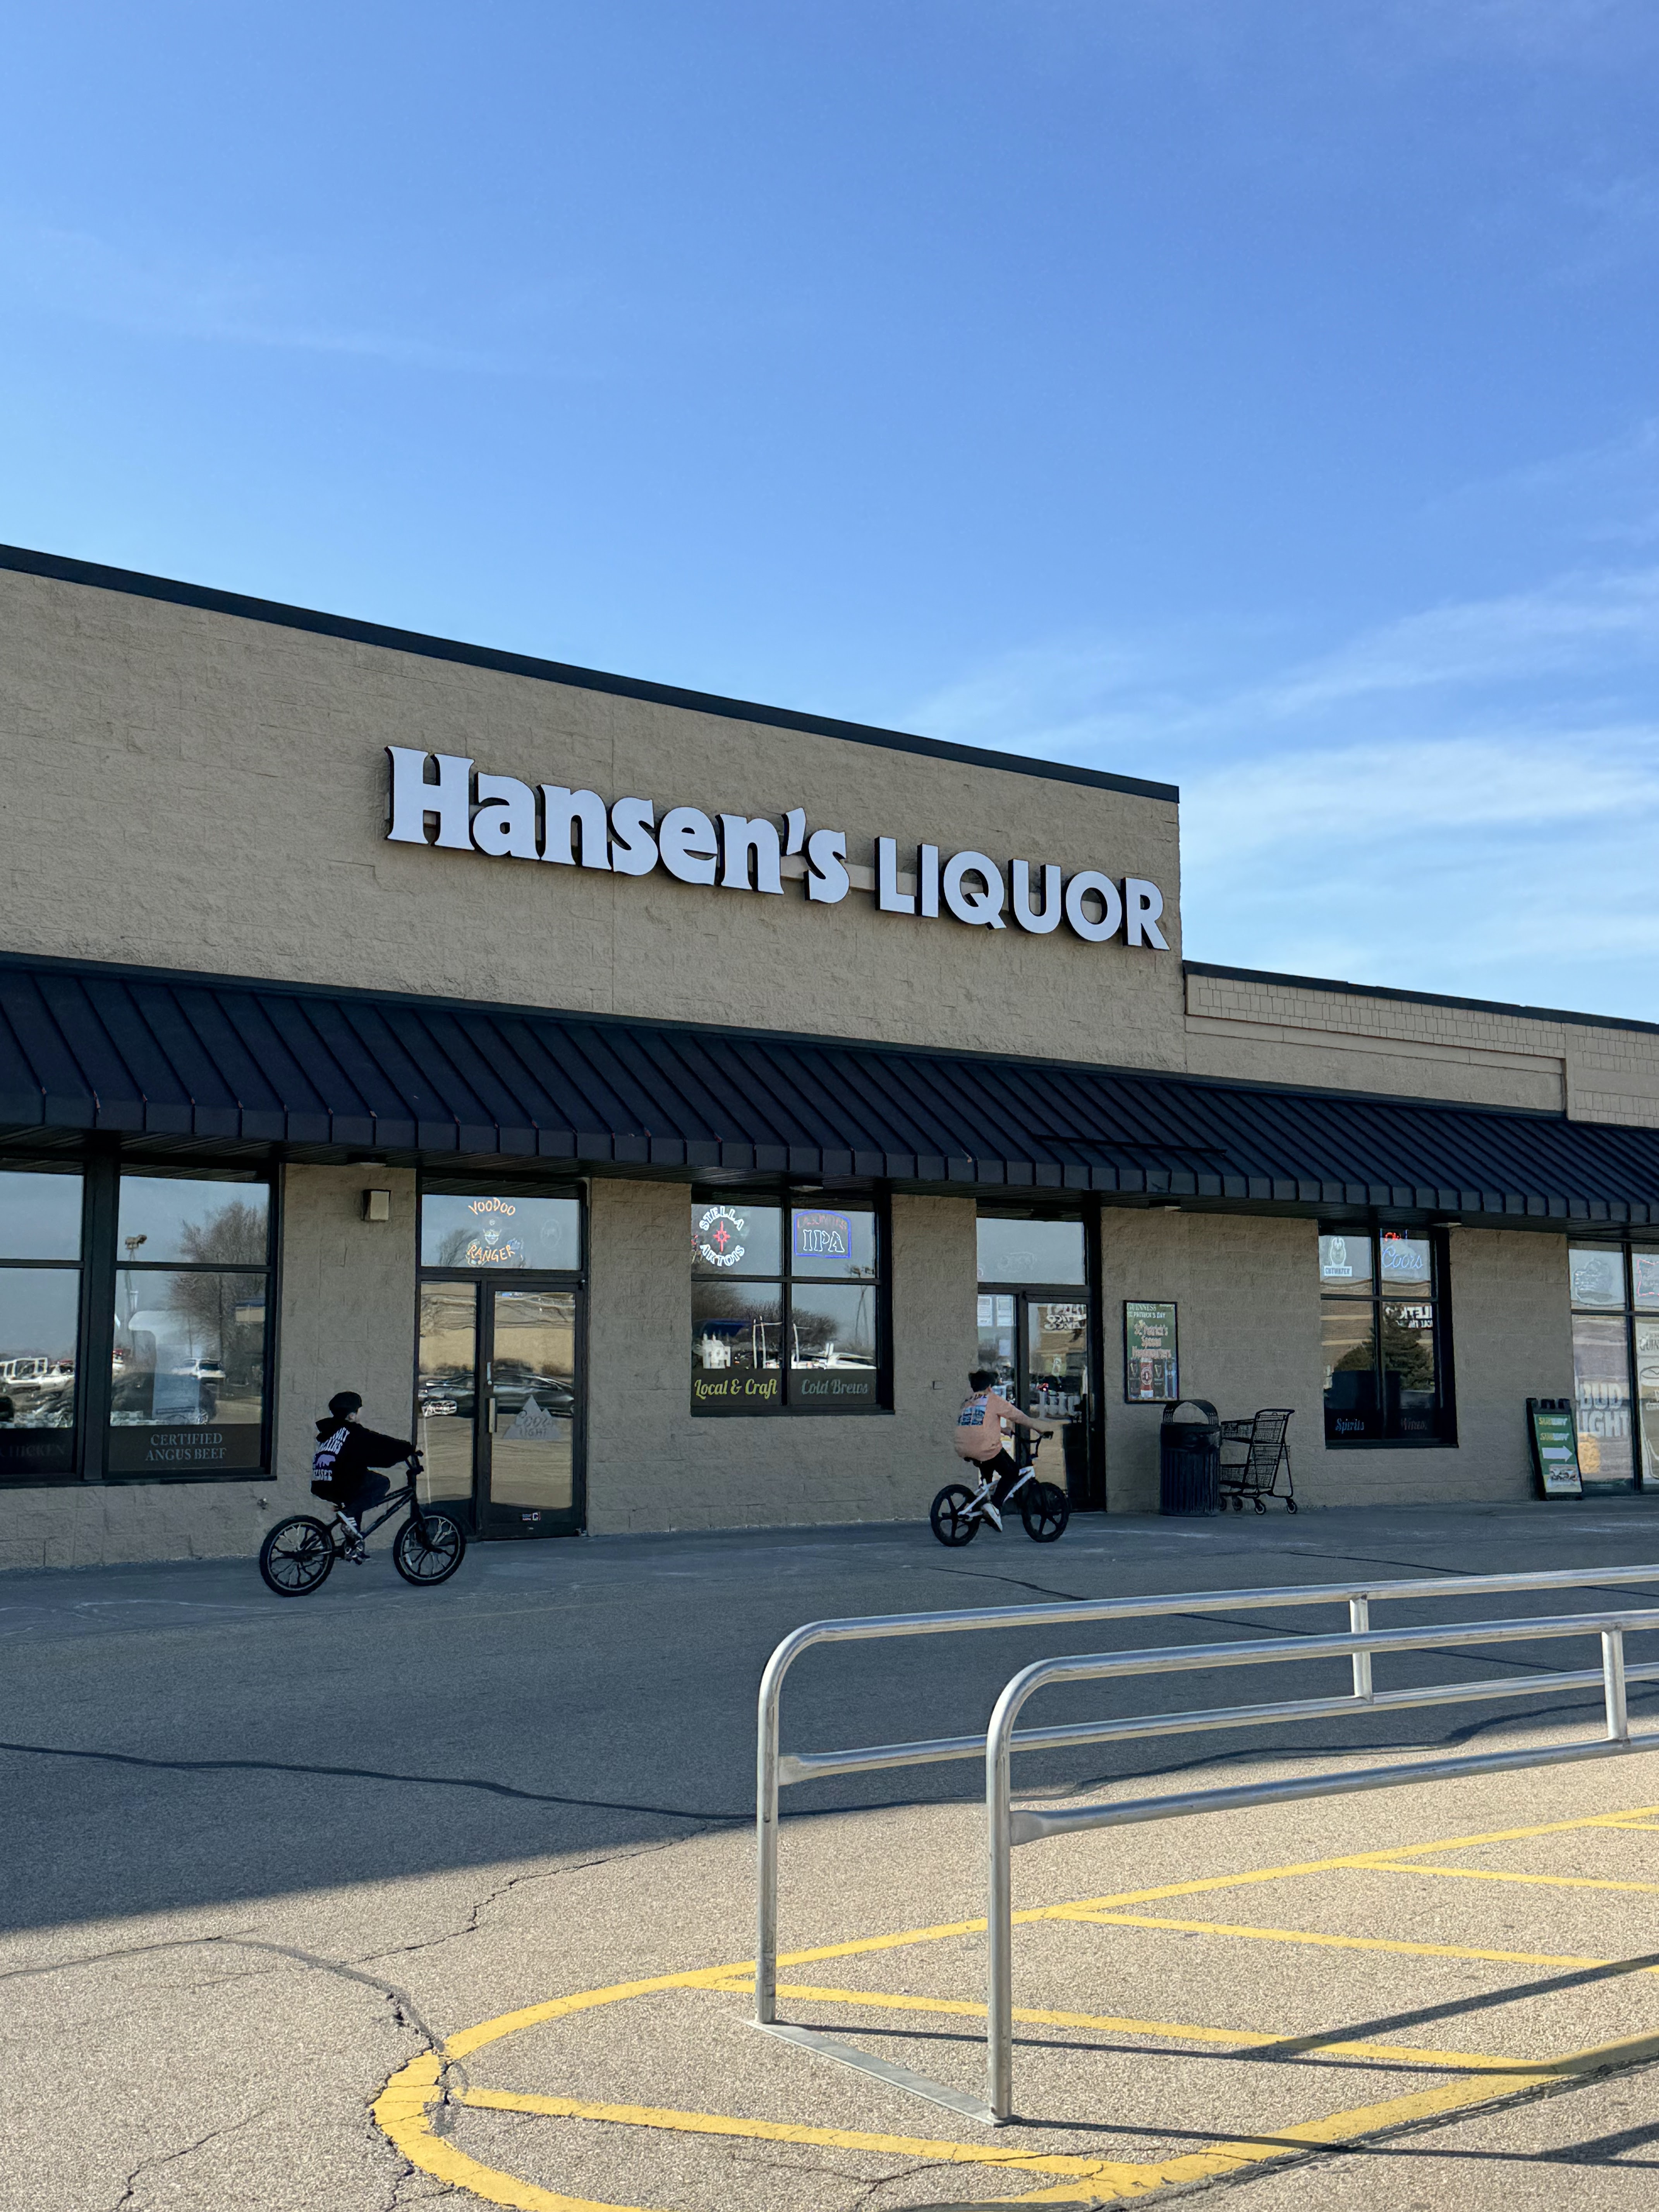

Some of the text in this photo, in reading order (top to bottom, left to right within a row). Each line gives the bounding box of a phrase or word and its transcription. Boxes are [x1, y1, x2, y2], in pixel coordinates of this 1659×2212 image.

[385, 745, 1170, 950] Hansen's LIQUOR
[468, 1197, 515, 1216] VOODOO
[699, 1206, 744, 1231] STELLA
[803, 1229, 845, 1252] IPA
[467, 1244, 515, 1262] RANGER
[699, 1244, 745, 1266] ARTOIS
[1382, 1246, 1423, 1269] Coors
[694, 1378, 778, 1400] Local & Craft
[802, 1378, 868, 1395] Cold Brews
[1335, 1418, 1365, 1434] Spirits
[150, 1433, 223, 1446] CERTIFIED
[145, 1447, 227, 1461] ANGUS BEEF
